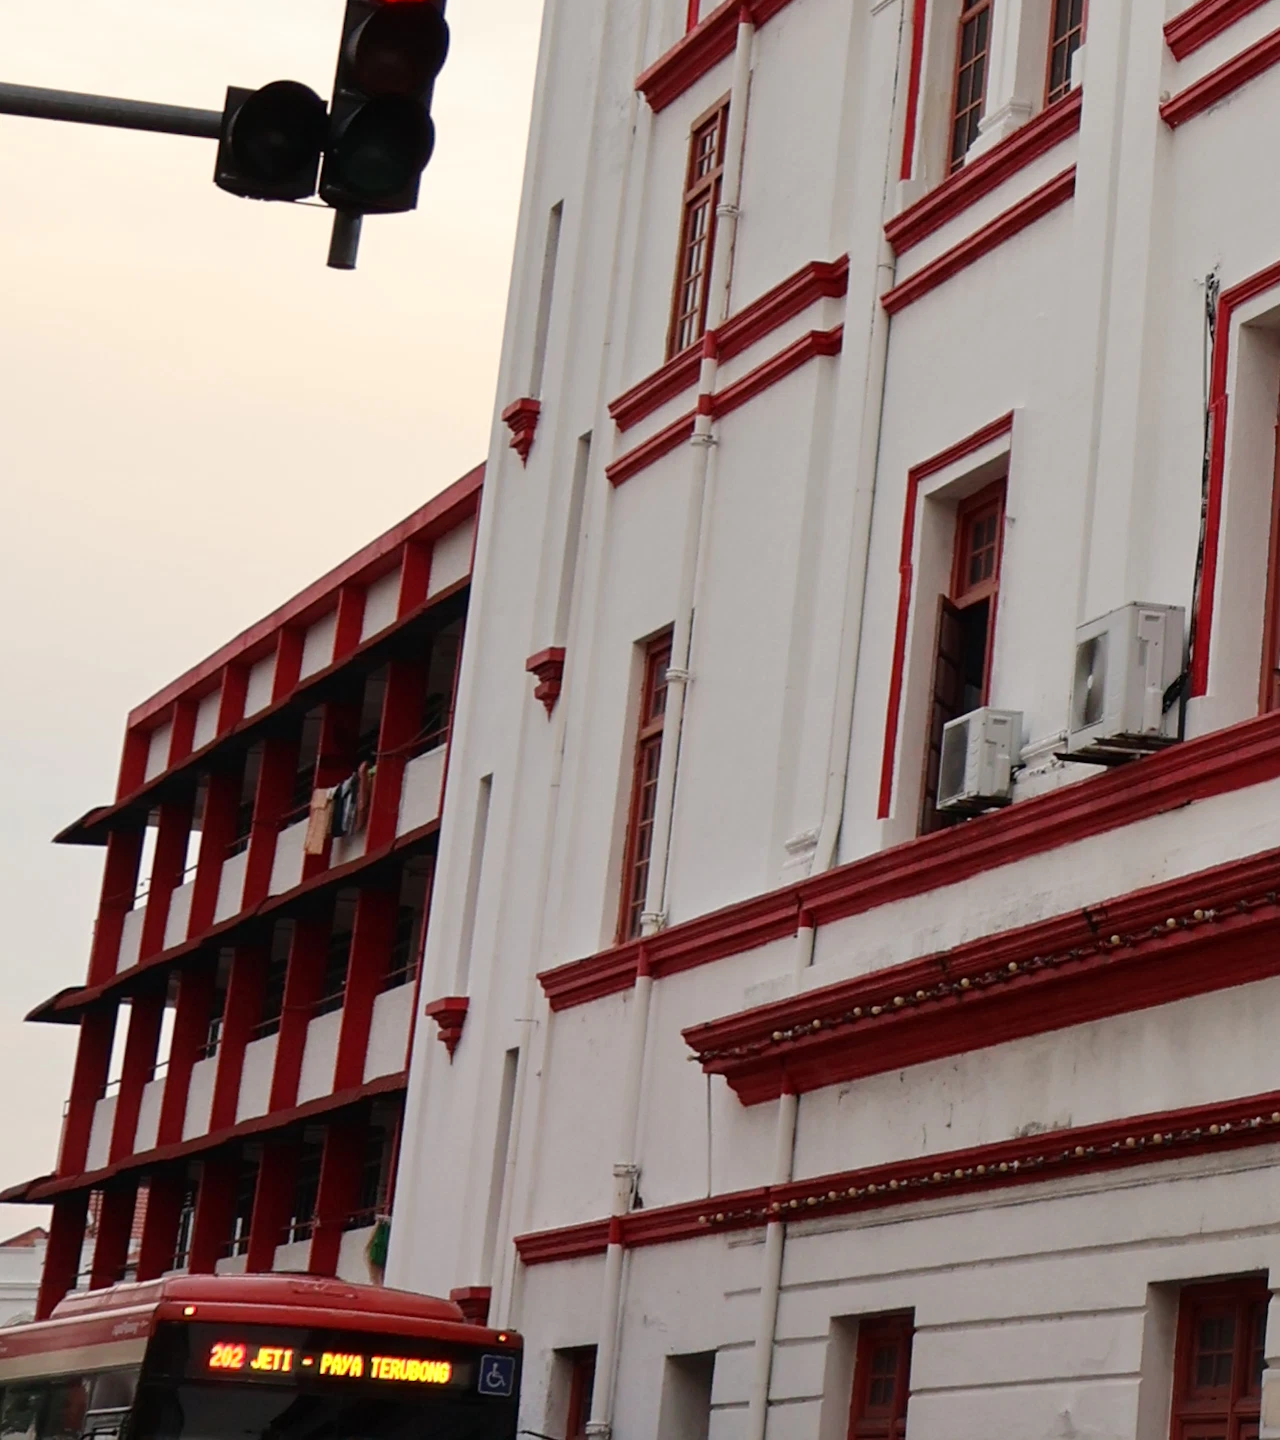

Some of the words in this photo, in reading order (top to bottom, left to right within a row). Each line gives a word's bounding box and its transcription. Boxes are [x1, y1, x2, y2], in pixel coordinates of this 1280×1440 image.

[209, 1342, 245, 1369] 202
[251, 1347, 293, 1371] JETI
[320, 1352, 364, 1377] PAYA
[370, 1356, 452, 1384] TERUBONG
